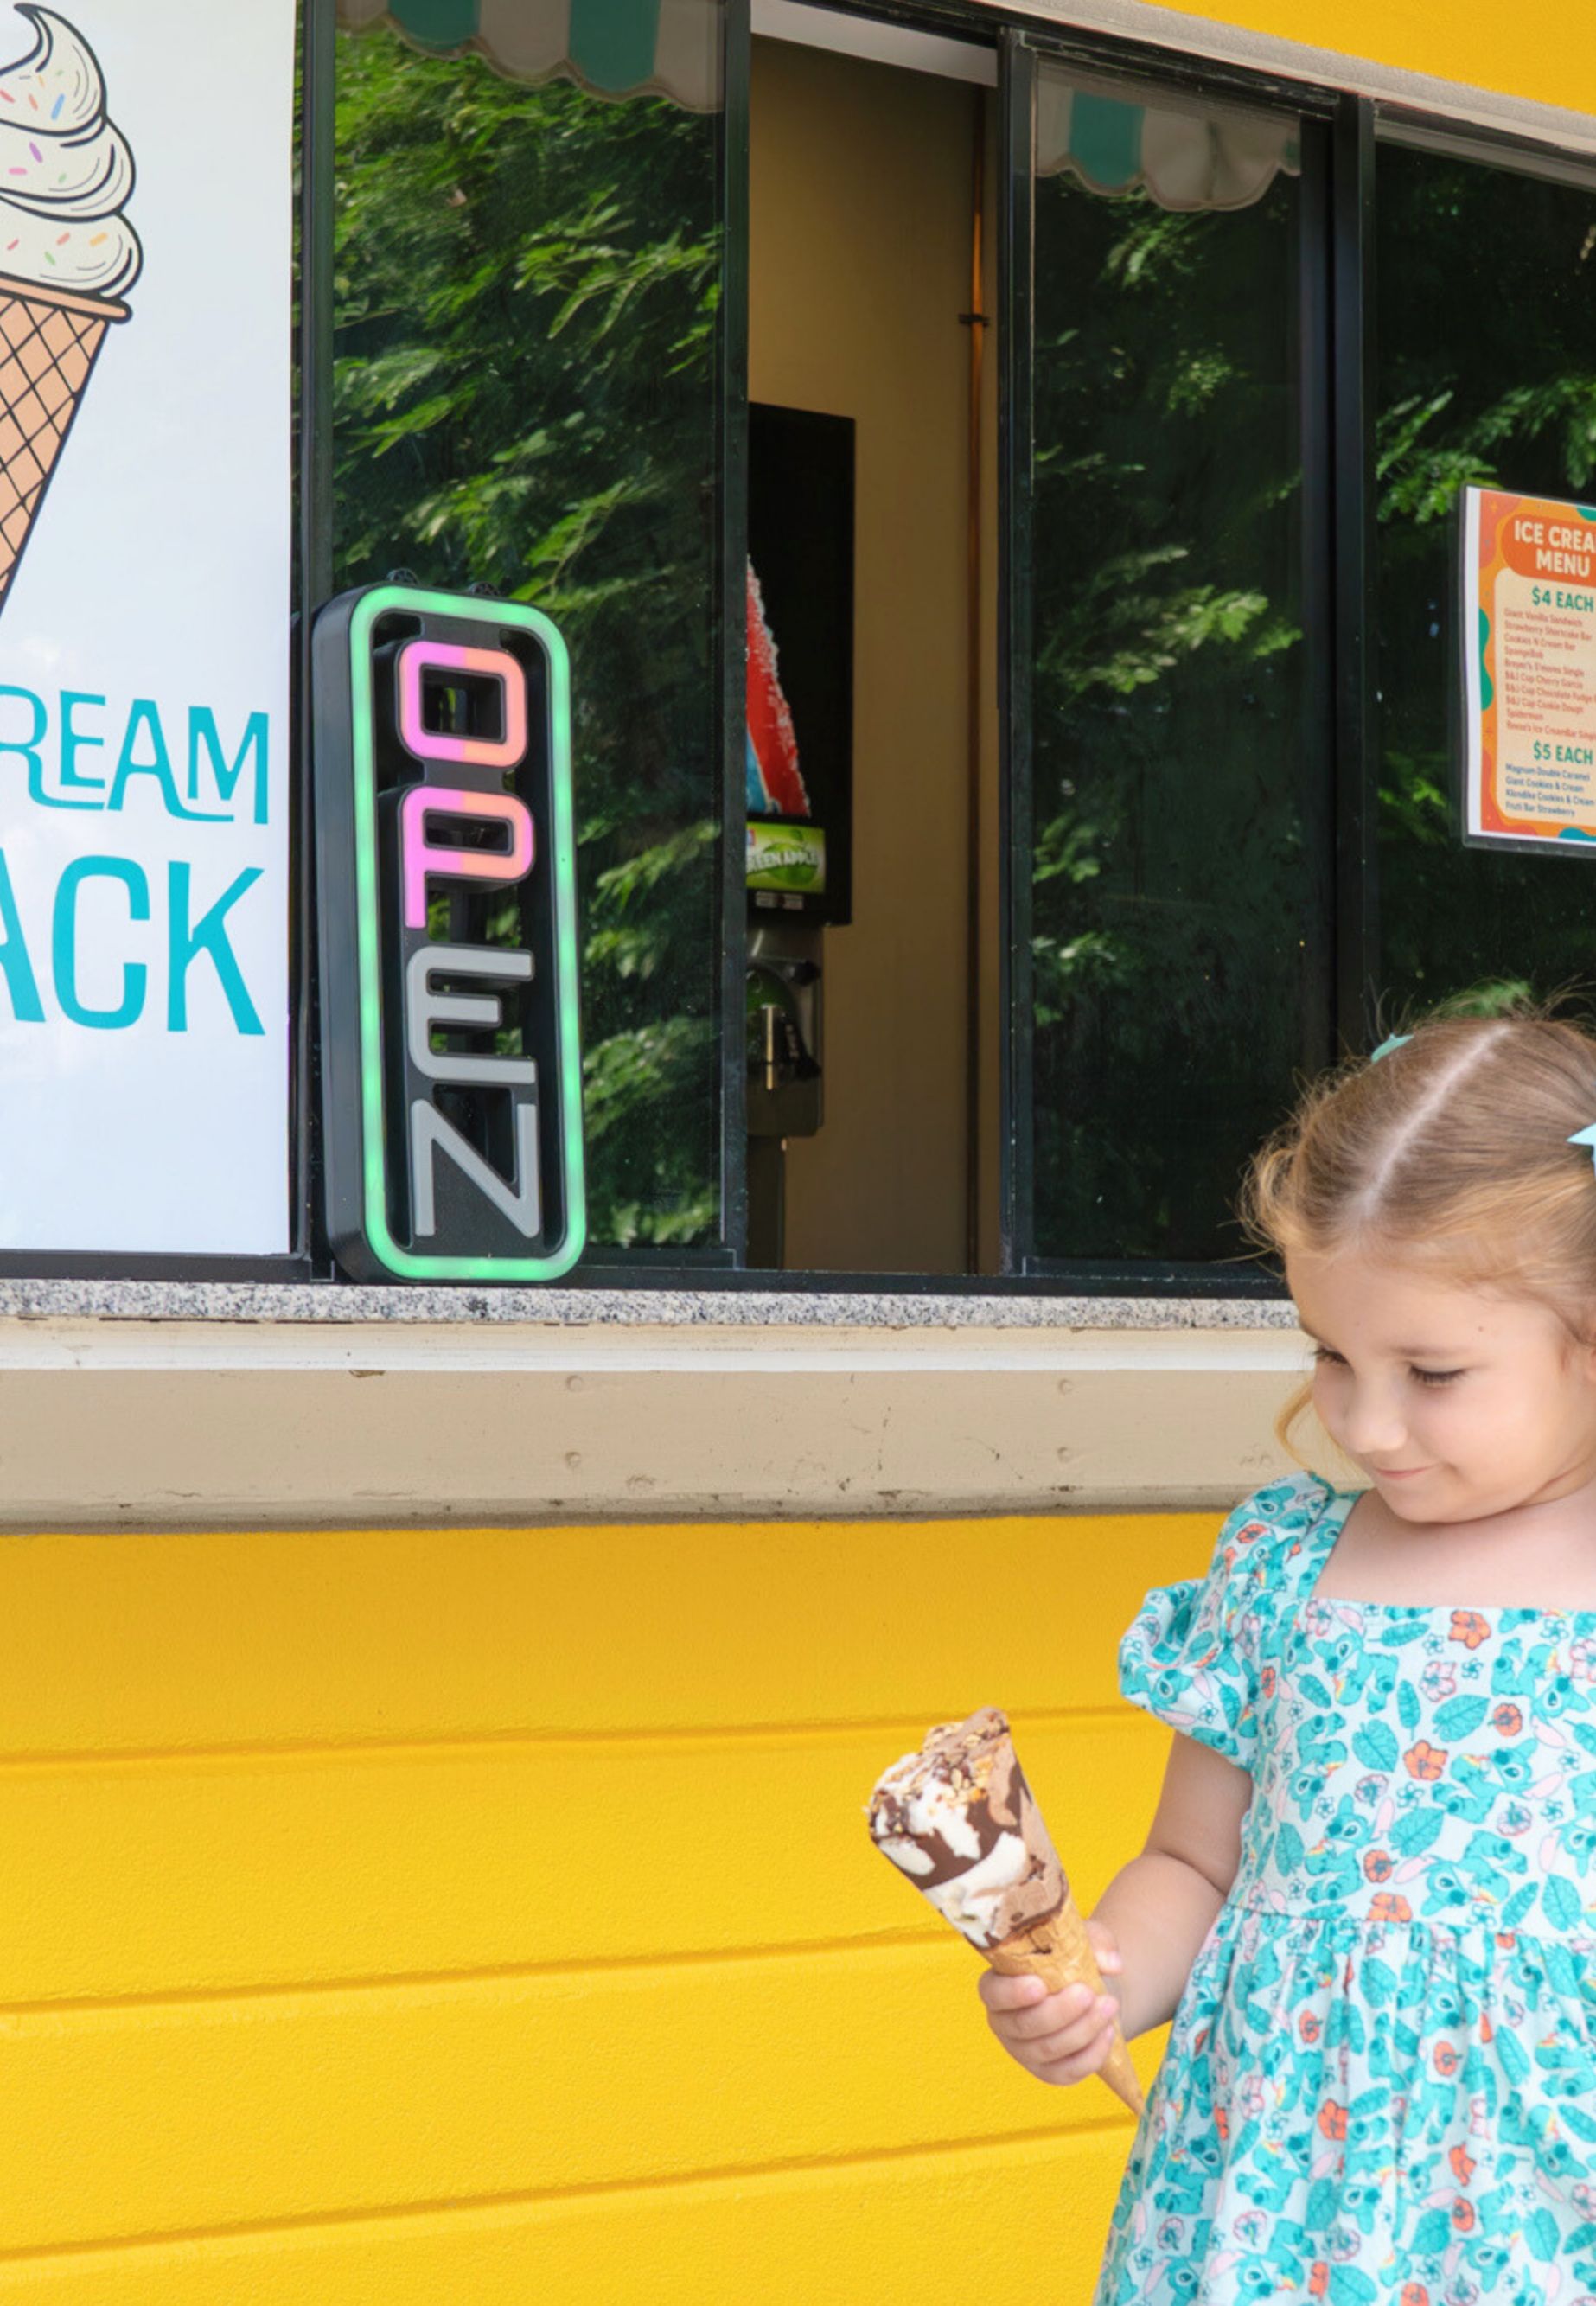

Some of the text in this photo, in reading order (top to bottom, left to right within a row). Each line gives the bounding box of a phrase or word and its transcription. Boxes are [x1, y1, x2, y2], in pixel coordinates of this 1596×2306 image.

[1514, 520, 1544, 546] ICE
[1535, 548, 1591, 578] MENU
[1531, 585, 1594, 612] $4 EACH
[1525, 611, 1548, 623] Vanilla
[1504, 620, 1543, 634] Strawberry
[1580, 632, 1592, 642] Bar
[1504, 633, 1531, 645] Cookies
[1539, 638, 1563, 649] Cream
[1564, 642, 1575, 652] Bar
[1521, 674, 1535, 683] Cup
[1536, 676, 1560, 687] Cherry
[1521, 686, 1535, 695] Cup
[1522, 698, 1535, 707] Cup
[1533, 739, 1593, 765] $5 EACH
[1536, 767, 1561, 778] Double
[1526, 778, 1553, 789] Cookies
[1562, 783, 1584, 792] Cream
[1537, 792, 1563, 802] Cookies
[1573, 796, 1595, 806] Cream
[1537, 805, 1575, 815] Strawberry
[398, 640, 541, 1238] OPEN
